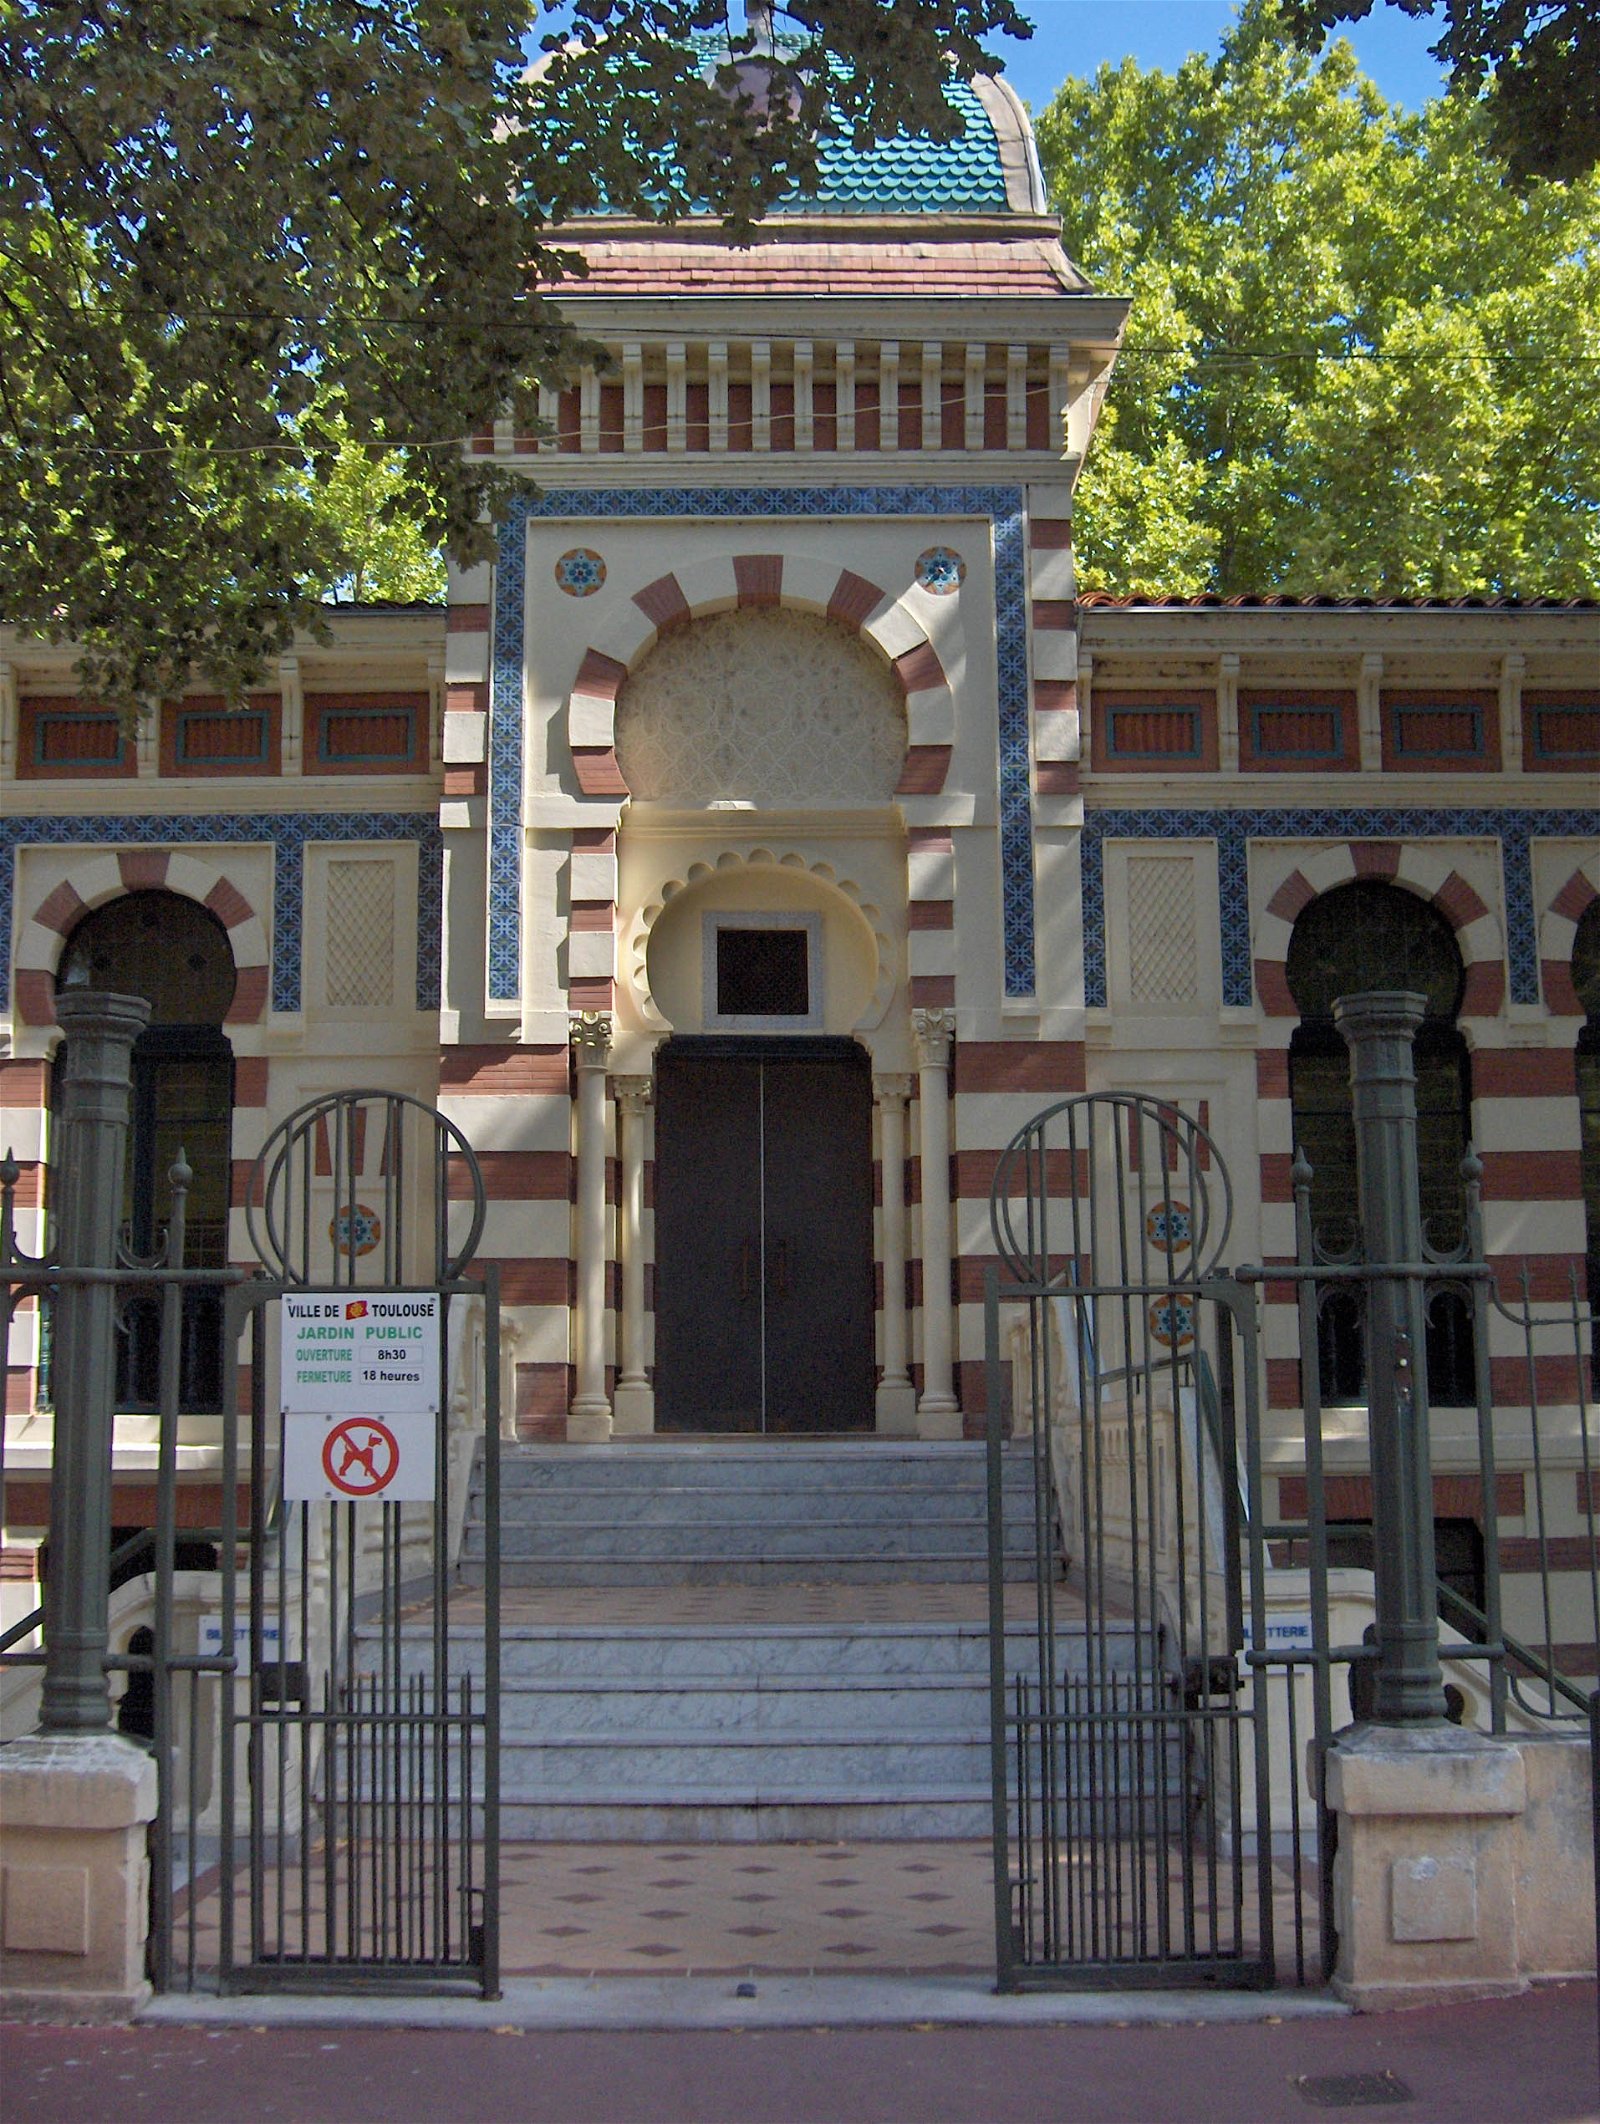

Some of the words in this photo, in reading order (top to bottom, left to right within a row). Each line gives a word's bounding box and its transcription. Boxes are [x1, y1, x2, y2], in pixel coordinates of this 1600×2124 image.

[288, 1305, 321, 1318] VILLE
[324, 1305, 340, 1318] DE
[372, 1303, 435, 1317] TOULOUSE
[297, 1326, 355, 1339] JARDIN
[366, 1326, 423, 1339] PUBLIC
[296, 1348, 352, 1361] OUVERTURE
[378, 1349, 406, 1360] 8h30
[296, 1370, 352, 1383] FERMETURE
[363, 1370, 376, 1381] 18
[380, 1370, 420, 1381] heures
